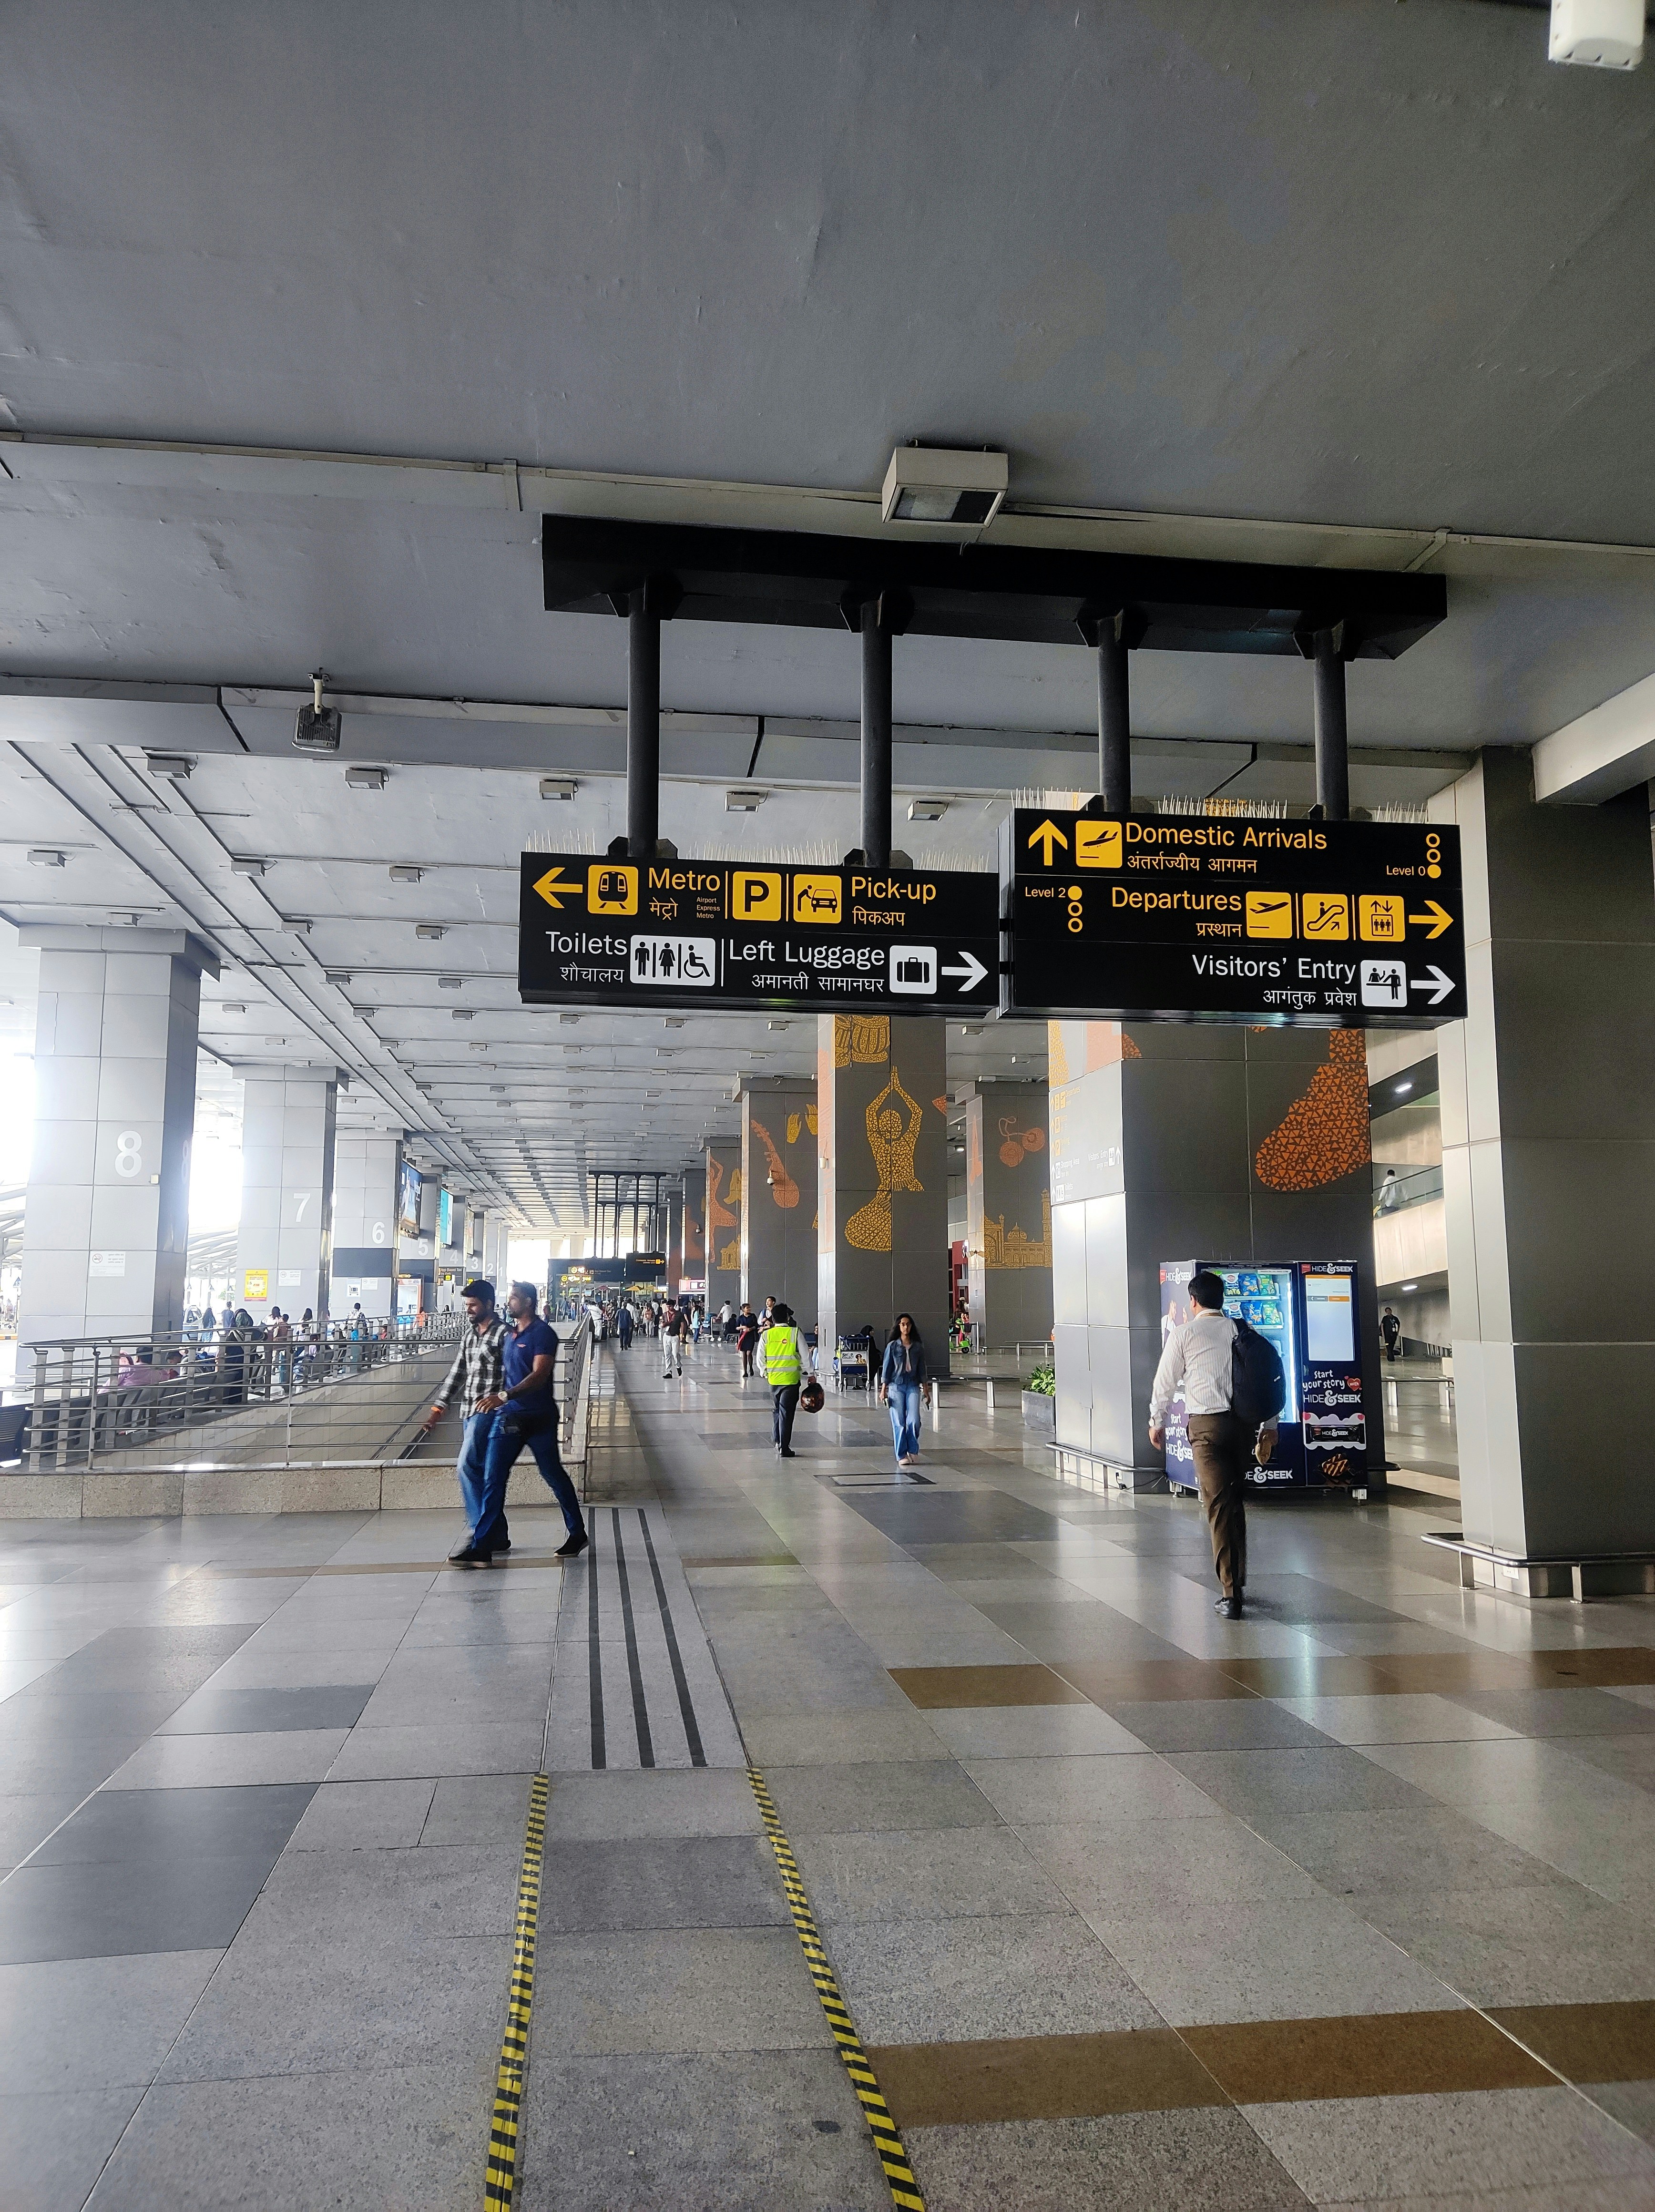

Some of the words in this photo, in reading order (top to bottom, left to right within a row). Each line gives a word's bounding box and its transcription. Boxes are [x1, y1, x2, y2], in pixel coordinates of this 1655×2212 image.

[1126, 822, 1234, 846] Domestic
[1243, 827, 1327, 849] Arrivals
[1208, 859, 1257, 873] आगमन
[1387, 865, 1414, 875] Level
[1419, 866, 1425, 876] 0
[649, 868, 720, 891] Metro
[745, 880, 769, 912] P
[852, 877, 936, 904] Pick-up
[1026, 887, 1053, 897] Level
[1058, 888, 1065, 898] 2
[1113, 887, 1241, 912] Departures
[649, 897, 678, 920] मेट्रो
[852, 906, 905, 926] पिकअप
[1196, 923, 1242, 937] प्रस्थान
[546, 932, 627, 955] Toilets
[730, 940, 775, 961] Left
[786, 942, 884, 970] Luggage
[560, 962, 624, 983] शौचालय
[1298, 958, 1356, 984] Entry
[752, 972, 809, 990] अमानती
[817, 977, 884, 992] सामानघर
[1263, 986, 1316, 1009] आगंतुक
[1324, 987, 1357, 1006] प्रवेश
[115, 1130, 142, 1178] 8
[293, 1193, 310, 1222] 7
[372, 1222, 385, 1244] 6
[418, 1238, 428, 1256] 5
[450, 1249, 458, 1264] 4
[471, 1257, 479, 1270] 3
[487, 1263, 494, 1274] 2
[499, 1267, 503, 1277] 1
[1312, 1263, 1353, 1274] HIDE&SEEK
[1314, 1370, 1334, 1379] Start
[1302, 1381, 1322, 1392] your
[1323, 1379, 1345, 1390] story
[1303, 1390, 1361, 1406] HIDE&SEEK
[1171, 1413, 1182, 1424] Start
[1165, 1427, 1176, 1440] your
[1176, 1426, 1188, 1441] story
[1166, 1440, 1193, 1462] HIDE&SEE
[1244, 1466, 1293, 1484] E&SEEK
